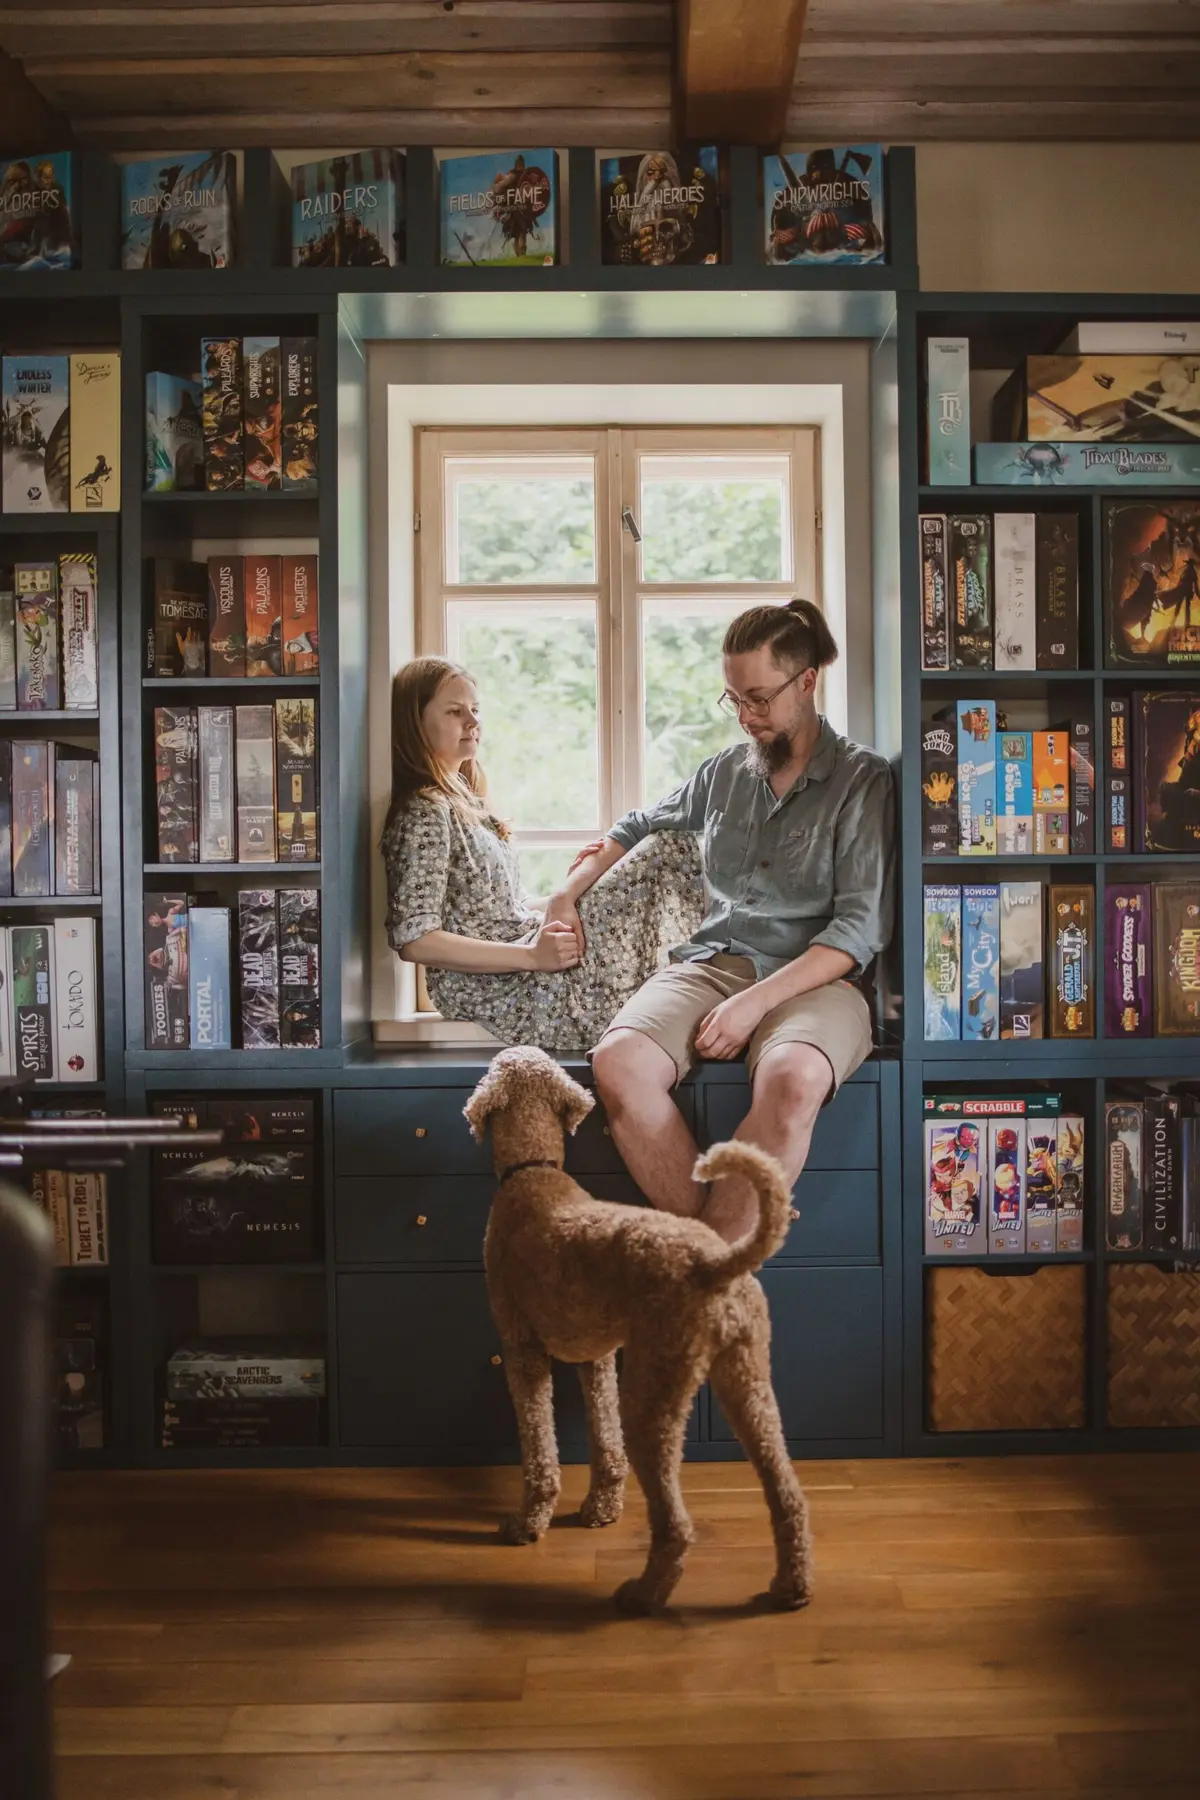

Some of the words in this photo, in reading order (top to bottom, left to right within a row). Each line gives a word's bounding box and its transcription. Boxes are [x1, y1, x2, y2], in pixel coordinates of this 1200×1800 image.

[130, 193, 172, 217] ROCKS
[184, 189, 216, 208] RUIN
[301, 185, 378, 221] RAIDERS
[450, 191, 494, 214] FIELDS
[496, 195, 505, 204] OF
[507, 187, 543, 206] FAME
[610, 193, 641, 213] HALL
[654, 185, 705, 206] HEROES
[773, 181, 871, 211] SHIPWRIGHTS
[16, 369, 52, 380] ENDLESS
[18, 383, 52, 394] WINTER
[221, 348, 233, 393] PILLARDS
[249, 352, 260, 399] SHIPWRIGHTS
[289, 354, 299, 396] EXPLORERS
[1081, 447, 1117, 469] TIDAL
[1116, 447, 1167, 470] BLADES
[220, 566, 232, 614] VISCOUNTS
[256, 566, 268, 614] PALADINS
[295, 566, 305, 613] ARCHITECTS
[956, 557, 967, 628] STEAMPUNK
[1015, 567, 1024, 618] BRASS
[1056, 565, 1066, 617] BRASS
[29, 645, 44, 701] TAKENOKO
[923, 742, 954, 755] TOKYO
[961, 762, 972, 801] KORO
[1005, 762, 1015, 802] KORO
[1075, 785, 1090, 806] SUPER
[66, 789, 79, 889] ADRENALINE
[961, 803, 972, 851] MACHI
[926, 888, 959, 897] KOSMOS
[964, 888, 997, 897] KOSMOS
[970, 931, 997, 969] City
[1062, 931, 1082, 960] J.T.
[1121, 915, 1134, 962] GODDESS
[242, 952, 264, 987] DEAD
[281, 955, 301, 985] DEAD
[935, 952, 955, 997] Island
[967, 966, 984, 989] My
[1179, 928, 1200, 992] KINGDOM
[62, 970, 85, 1029] TOKAIDO
[1064, 963, 1075, 1001] GERALD
[1122, 963, 1134, 1002] SPIDER
[153, 983, 168, 1037] FOODIES
[196, 975, 212, 1044] PORTAL
[19, 1012, 39, 1071] SPIRITS
[38, 1038, 48, 1053] RICE
[965, 1102, 1023, 1113] SCRABBLE
[162, 1152, 205, 1160] NEMESIS
[1154, 1117, 1167, 1231] CIVILIZATION
[73, 1178, 88, 1206] RIDE
[1112, 1144, 1123, 1212] IMAGINARIUM
[77, 1219, 92, 1262] TICKET
[246, 1222, 301, 1232] NEMESIS
[934, 1220, 975, 1237] UNITED
[992, 1220, 1022, 1232] UNITED
[224, 1375, 282, 1385] SCAVENGERS
[237, 1366, 270, 1376] ARCTIC
